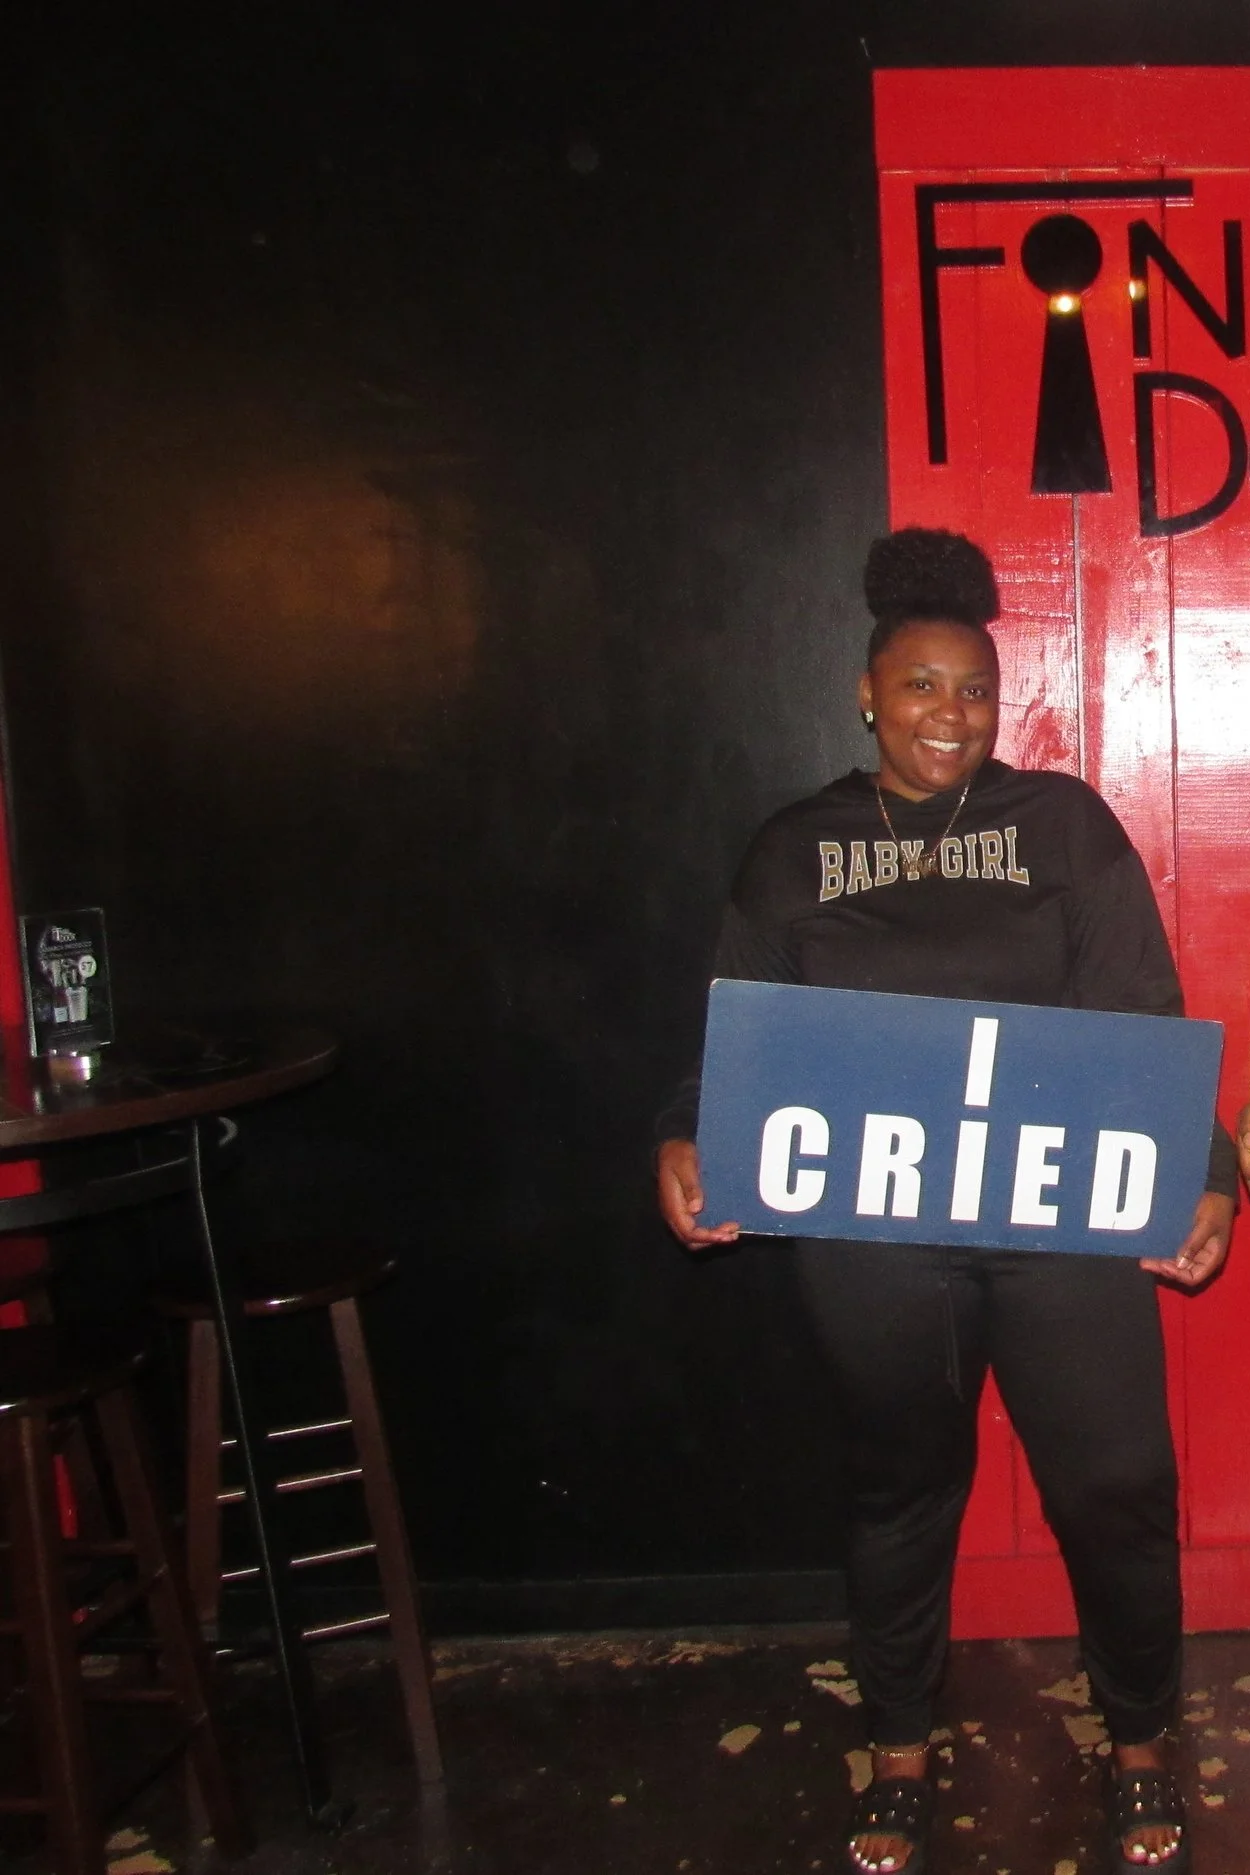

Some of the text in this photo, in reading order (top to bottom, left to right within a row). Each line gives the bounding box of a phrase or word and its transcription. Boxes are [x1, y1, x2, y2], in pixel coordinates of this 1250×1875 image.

[818, 825, 1031, 903] BABY GIRL
[963, 1016, 999, 1107] I
[758, 1105, 1159, 1233] CRIED
